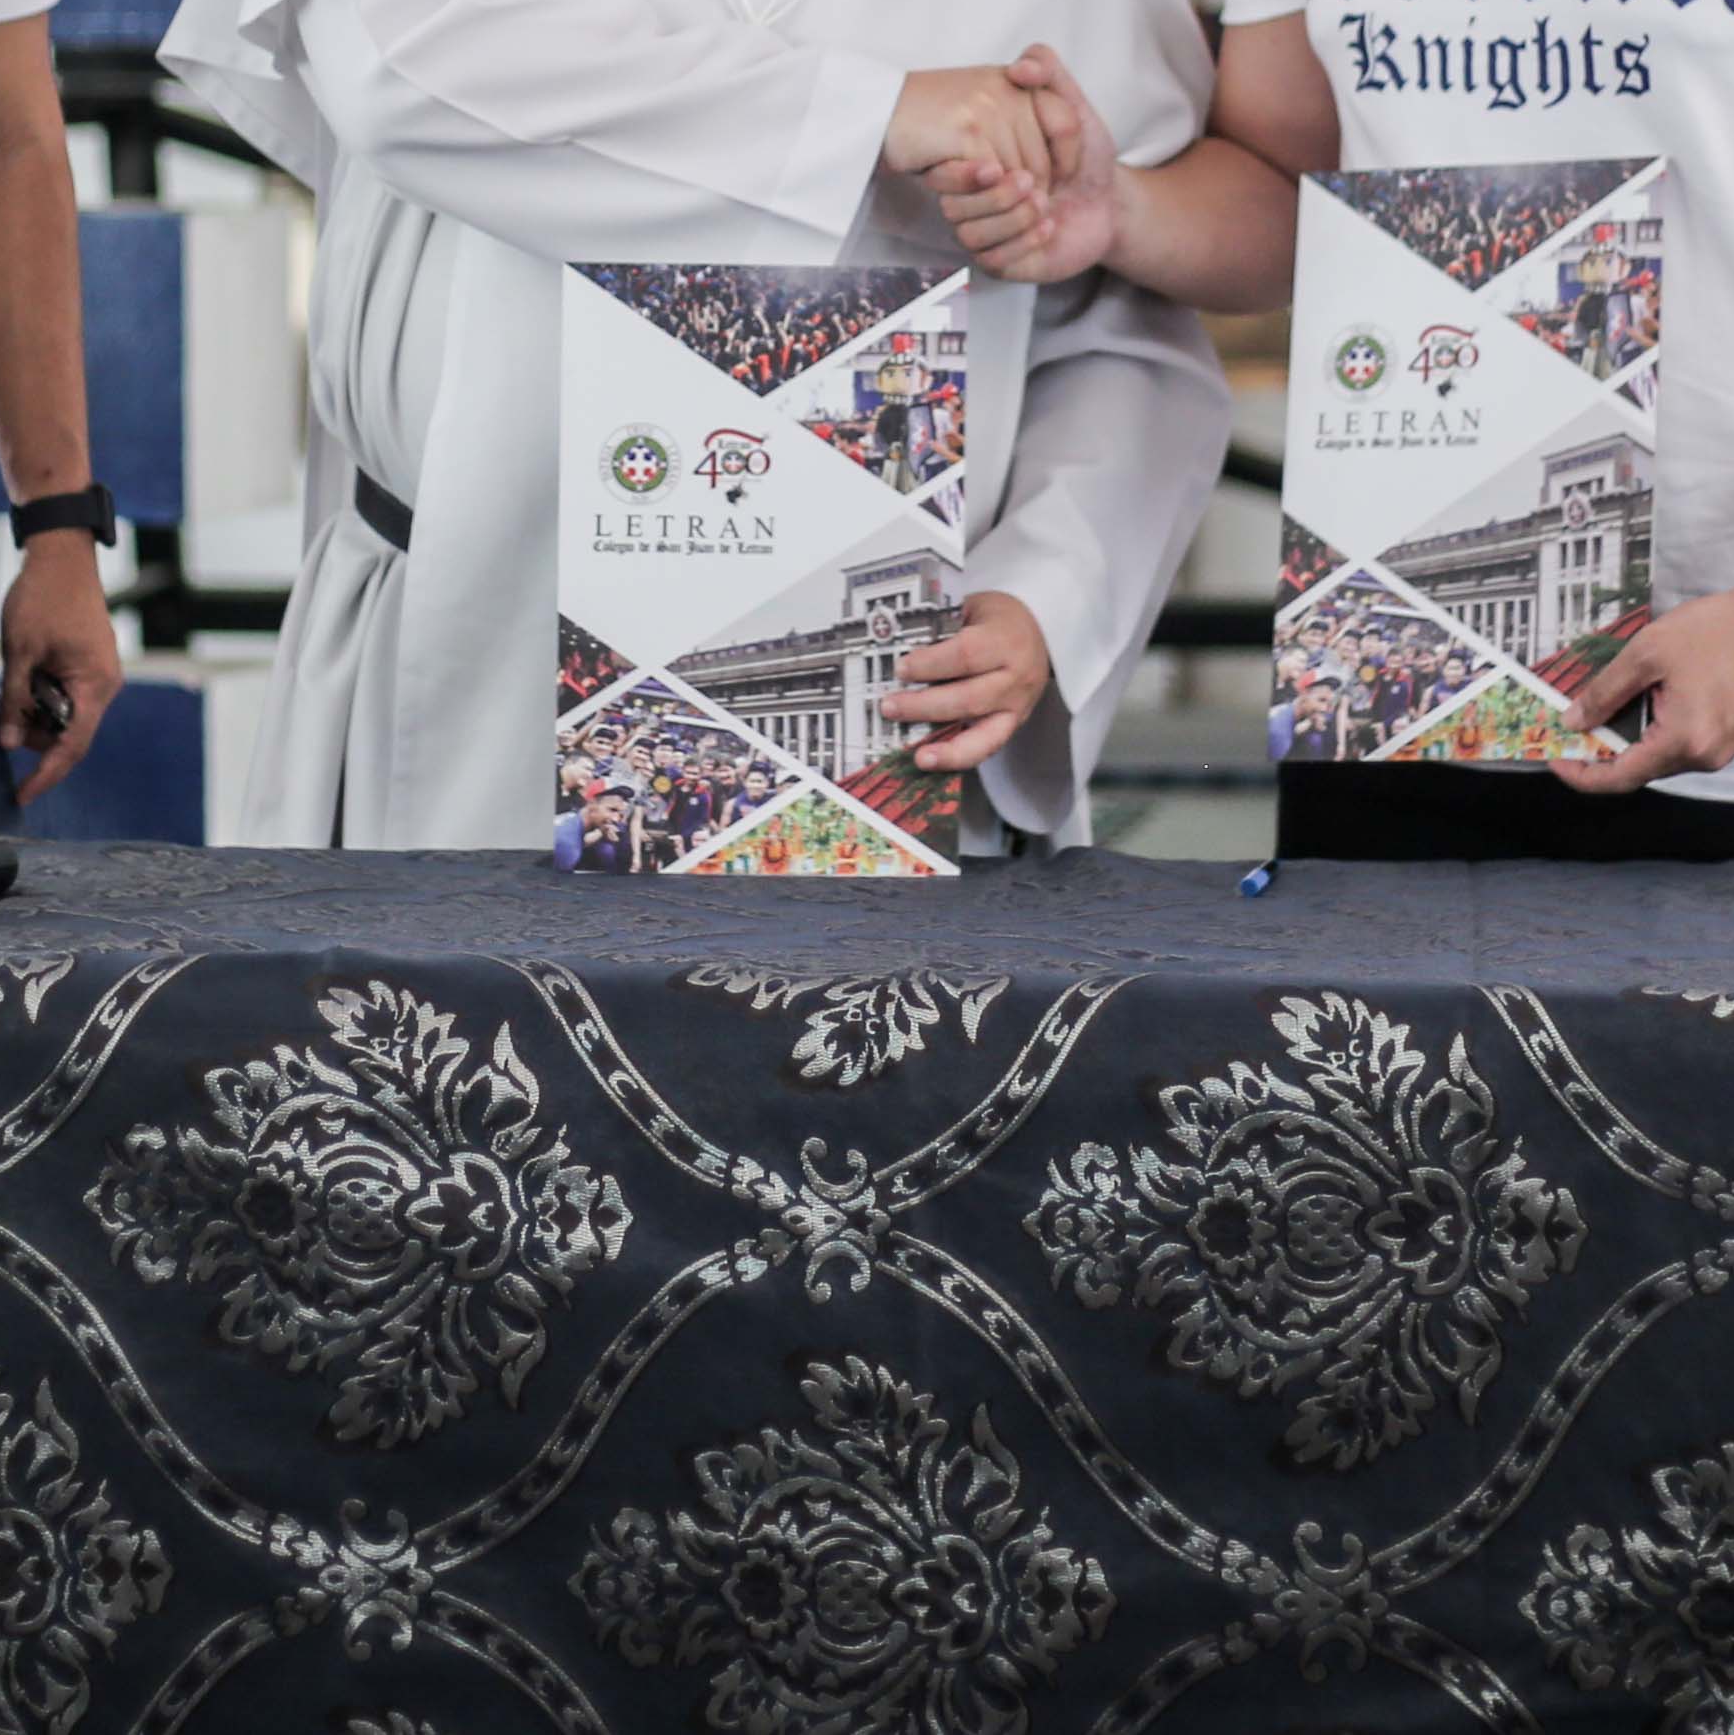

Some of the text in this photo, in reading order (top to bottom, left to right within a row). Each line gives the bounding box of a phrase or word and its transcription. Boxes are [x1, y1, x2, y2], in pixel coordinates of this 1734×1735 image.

[1339, 11, 1651, 110] Knights
[1317, 409, 1481, 435] LETRAN
[594, 514, 775, 539] LETRAN
